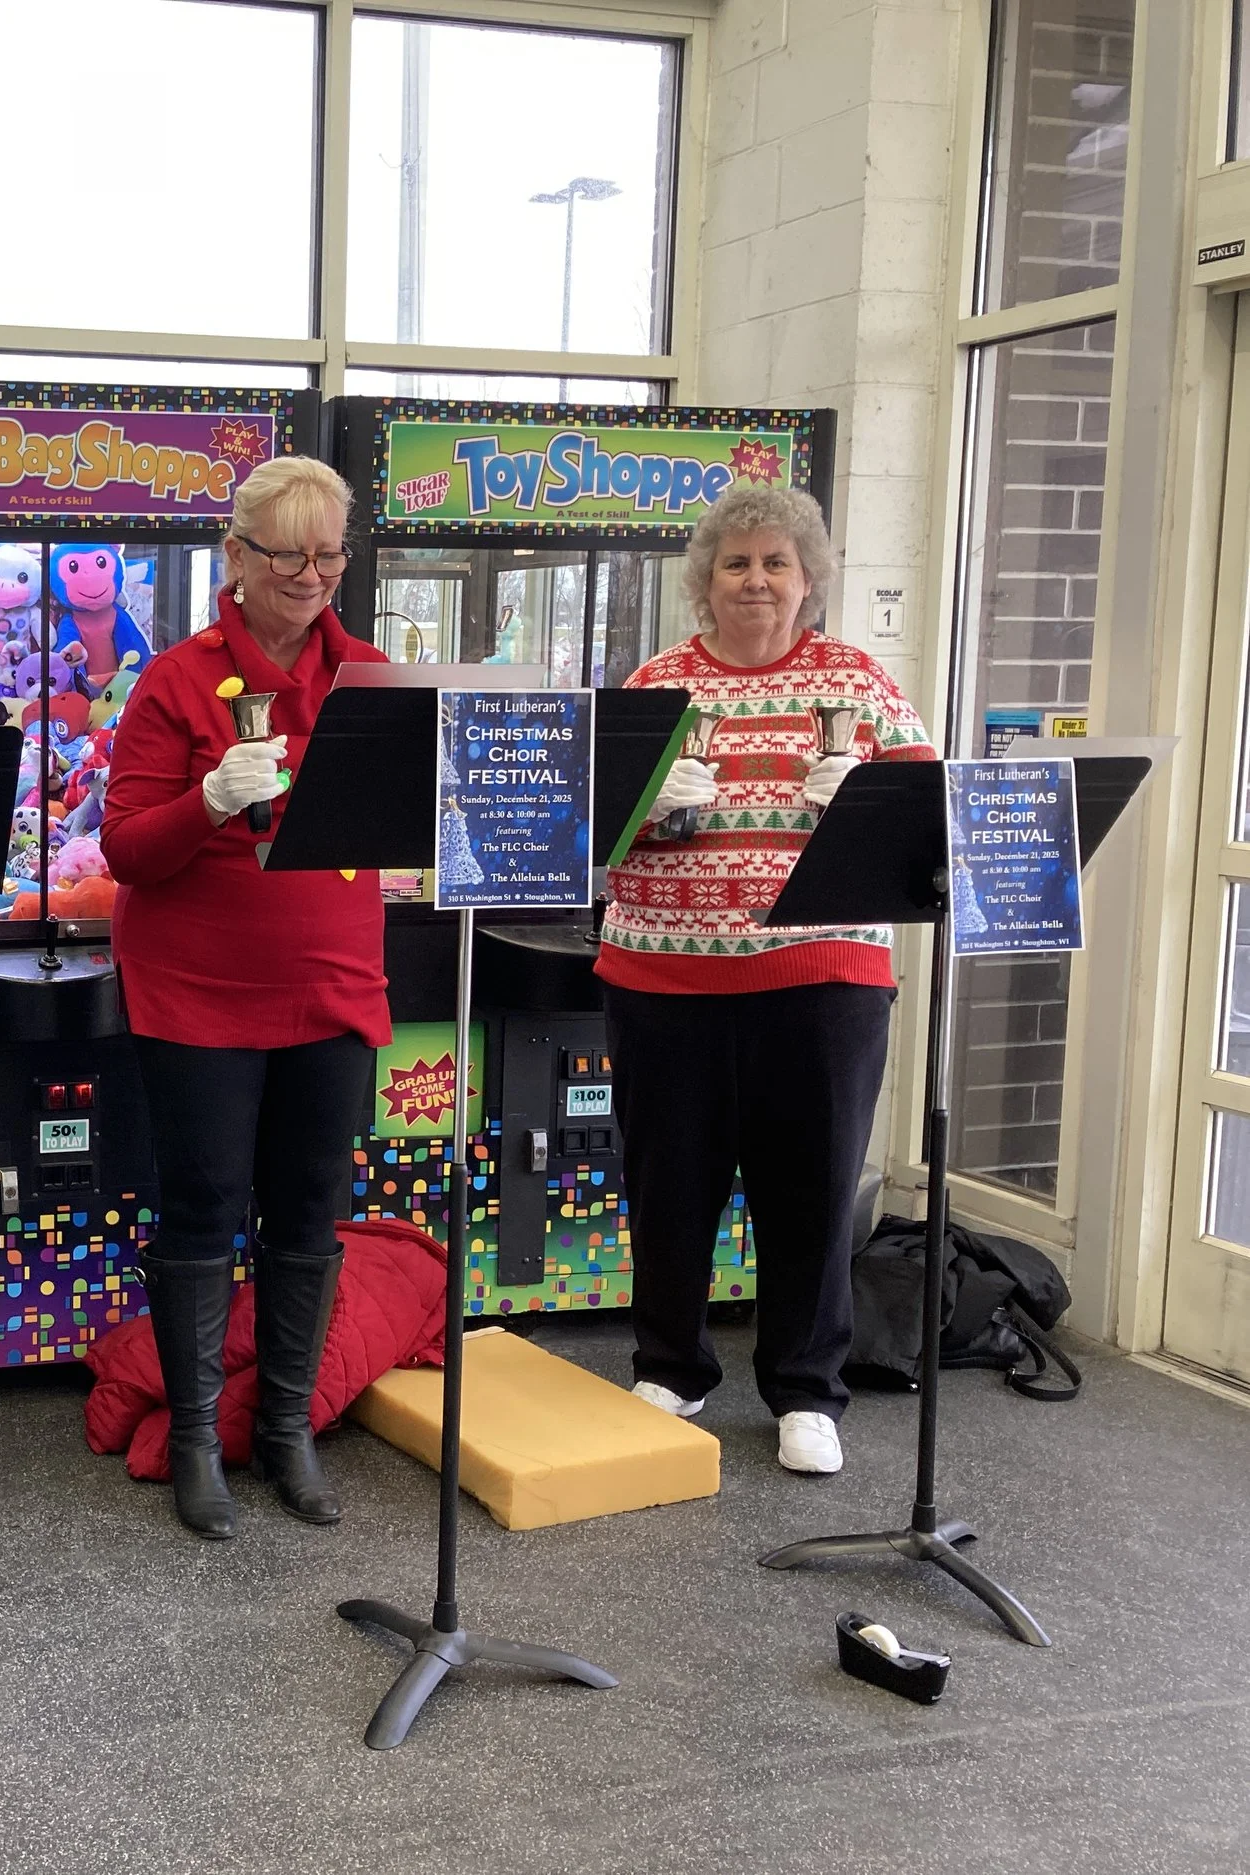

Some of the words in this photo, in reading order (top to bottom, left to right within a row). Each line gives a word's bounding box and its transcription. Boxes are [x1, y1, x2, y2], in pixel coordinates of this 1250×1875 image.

[1199, 243, 1244, 262] STANLEY
[225, 427, 254, 440] PLAY
[223, 442, 251, 455] WIN!
[233, 437, 243, 446] &
[743, 446, 774, 460] PLAY
[75, 420, 237, 503] Shoppe
[751, 457, 762, 467] &
[452, 435, 547, 516] Toy
[543, 431, 734, 514] Shoppe
[741, 462, 770, 477] WIN!
[9, 495, 18, 504] A
[20, 495, 45, 504] Test
[49, 496, 62, 505] of
[65, 496, 92, 505] Skill
[556, 510, 565, 518] A
[567, 510, 590, 518] Test
[593, 510, 604, 518] of
[606, 510, 630, 519] Skill
[883, 609, 891, 627] 1
[475, 699, 500, 713] First
[504, 699, 566, 713] Lutheran's
[465, 726, 573, 741] CHRISTMAS
[488, 747, 548, 762] CHOIR
[468, 769, 568, 784] FESTIVAL
[974, 768, 995, 781] First
[998, 767, 1050, 781] Lutheran's
[461, 795, 494, 805] Sunday,
[496, 794, 537, 803] December
[539, 795, 551, 804] 21,
[552, 794, 572, 803] 2025
[968, 792, 1057, 806] CHRISTMAS
[986, 810, 1036, 824] CHOIR
[494, 825, 532, 838] featuring
[971, 829, 1055, 845] FESTIVAL
[482, 843, 499, 852] The
[502, 843, 521, 851] FLC
[523, 842, 549, 851] Choir
[967, 853, 993, 863] Sunday,
[994, 852, 1029, 861] December
[1030, 851, 1041, 860] 21,
[1042, 851, 1060, 859] 2025
[490, 873, 508, 882] The
[510, 873, 545, 882] Alleluia
[548, 872, 571, 882] Bells
[394, 1073, 437, 1092] GRAB
[411, 1081, 446, 1097] SOME
[402, 1090, 455, 1112] FUN!
[574, 1090, 606, 1101] $1.00
[572, 1102, 583, 1112] TO
[585, 1101, 606, 1112] PLAY
[51, 1125, 77, 1137] 50¢
[45, 1138, 58, 1149] TO
[60, 1136, 84, 1148] PLAY
